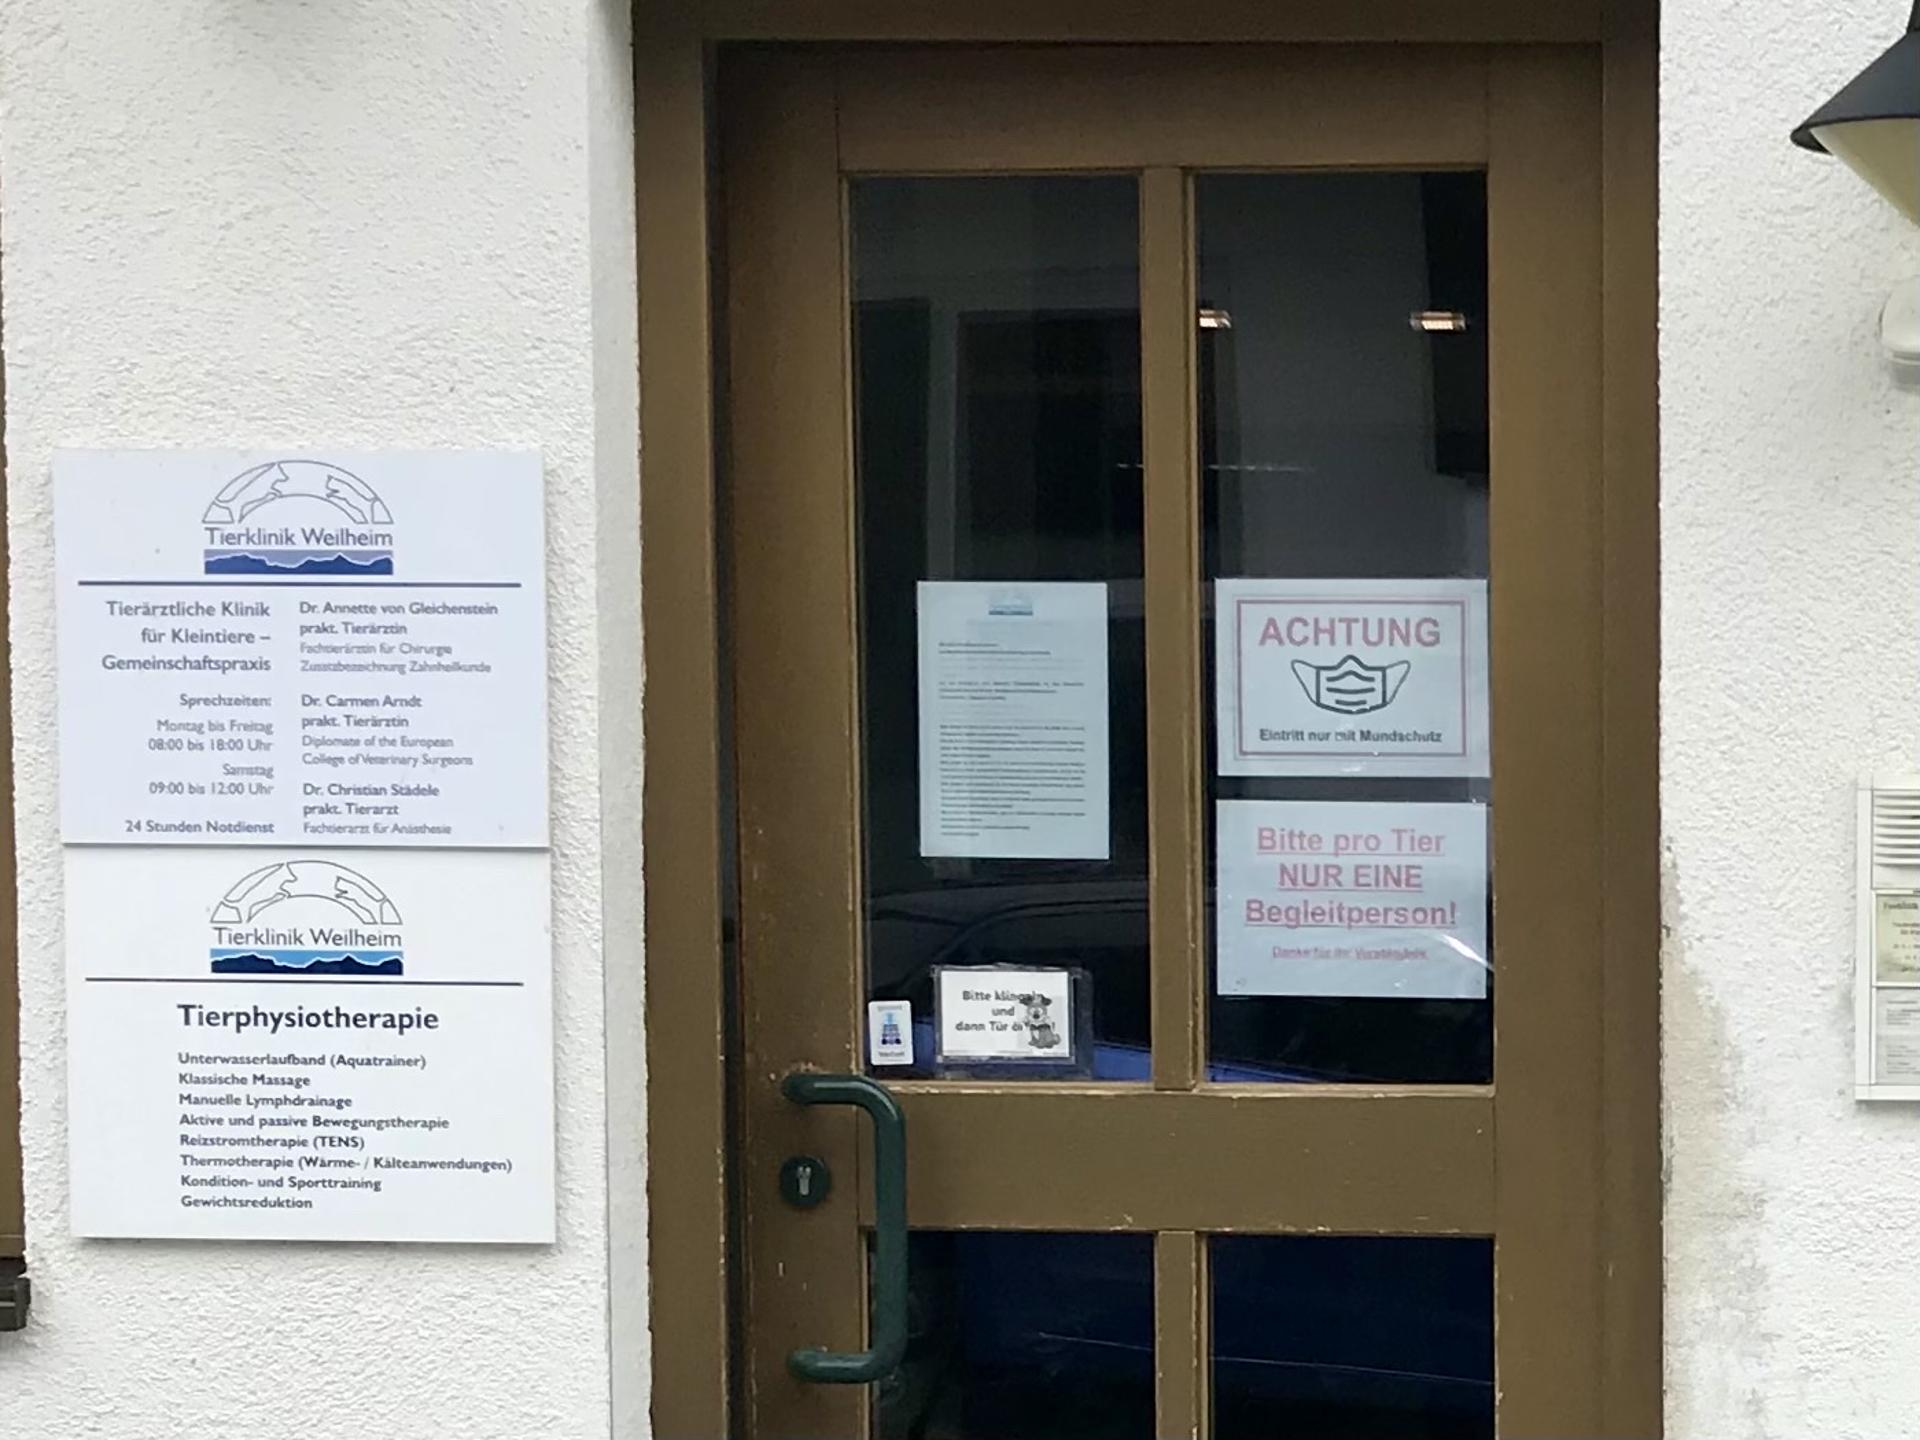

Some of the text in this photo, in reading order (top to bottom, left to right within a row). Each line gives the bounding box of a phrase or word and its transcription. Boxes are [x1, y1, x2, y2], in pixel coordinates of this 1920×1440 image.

[204, 527, 393, 548] Tierklinik Weilheim
[106, 601, 271, 617] Tierärztliche Klinik
[300, 601, 498, 615] Dr. Annette von Gleichenstein
[141, 628, 166, 643] für
[172, 628, 255, 644] Kleintiere
[300, 622, 408, 636] prakt. Tierärztin
[1259, 617, 1441, 648] ACHTUNG
[380, 643, 395, 655] für
[399, 643, 453, 657] Chirurgie
[101, 655, 272, 674] Gemeinschaftspraxis
[180, 693, 272, 709] Sprechzeiten:
[301, 694, 423, 708] Dr. Carmen Arndt
[156, 720, 274, 735] Montag bis Freitag
[302, 715, 409, 729] prakt. Tierärztin
[302, 735, 454, 749] Diplomate of the European
[1259, 728, 1305, 742] Eintritt
[1308, 730, 1331, 742] nur
[1360, 730, 1442, 743] Mundschutz
[148, 738, 273, 751] 08:00 bis 18:00 Uhr
[302, 754, 345, 768] College
[361, 754, 419, 768] Veterinary
[422, 754, 474, 768] Surgeons
[222, 763, 274, 779] Samstag
[149, 782, 274, 795] 09:00 bis 12:00 Uhr
[303, 783, 324, 796] Dr.
[327, 783, 387, 796] Christian
[303, 803, 399, 817] prakt. Tierarzt
[125, 820, 275, 834] 24 Stunden Notdienst
[373, 822, 389, 834] für
[1257, 827, 1446, 857] Bitte pro Tier
[1278, 863, 1424, 889] NUR EINE
[1245, 899, 1457, 930] Begleitperson!
[213, 927, 403, 947] Tierklinik Weilheim
[962, 990, 992, 1001] Bitte
[991, 1006, 1015, 1017] und
[177, 1004, 440, 1035] Tierphysiotherapie
[955, 1021, 986, 1031] dann
[989, 1020, 1008, 1031] Tür
[178, 1052, 427, 1069] Unterwasserlaufband (Aquatrainer)
[178, 1073, 311, 1088] Klassische Massage
[179, 1093, 353, 1110] Manuelle Lymphdrainage
[179, 1114, 450, 1131] Aktive und passive Bewegungstherapie
[180, 1134, 366, 1150] Reizstromtherapie (TENS)
[180, 1154, 294, 1170] Thermotherapie
[298, 1155, 361, 1171] (Wärme-
[374, 1156, 513, 1173] Kälteanwendungen)
[181, 1175, 382, 1192] Kondition- und Sporttraining
[181, 1195, 313, 1210] Gewichtsreduktion
